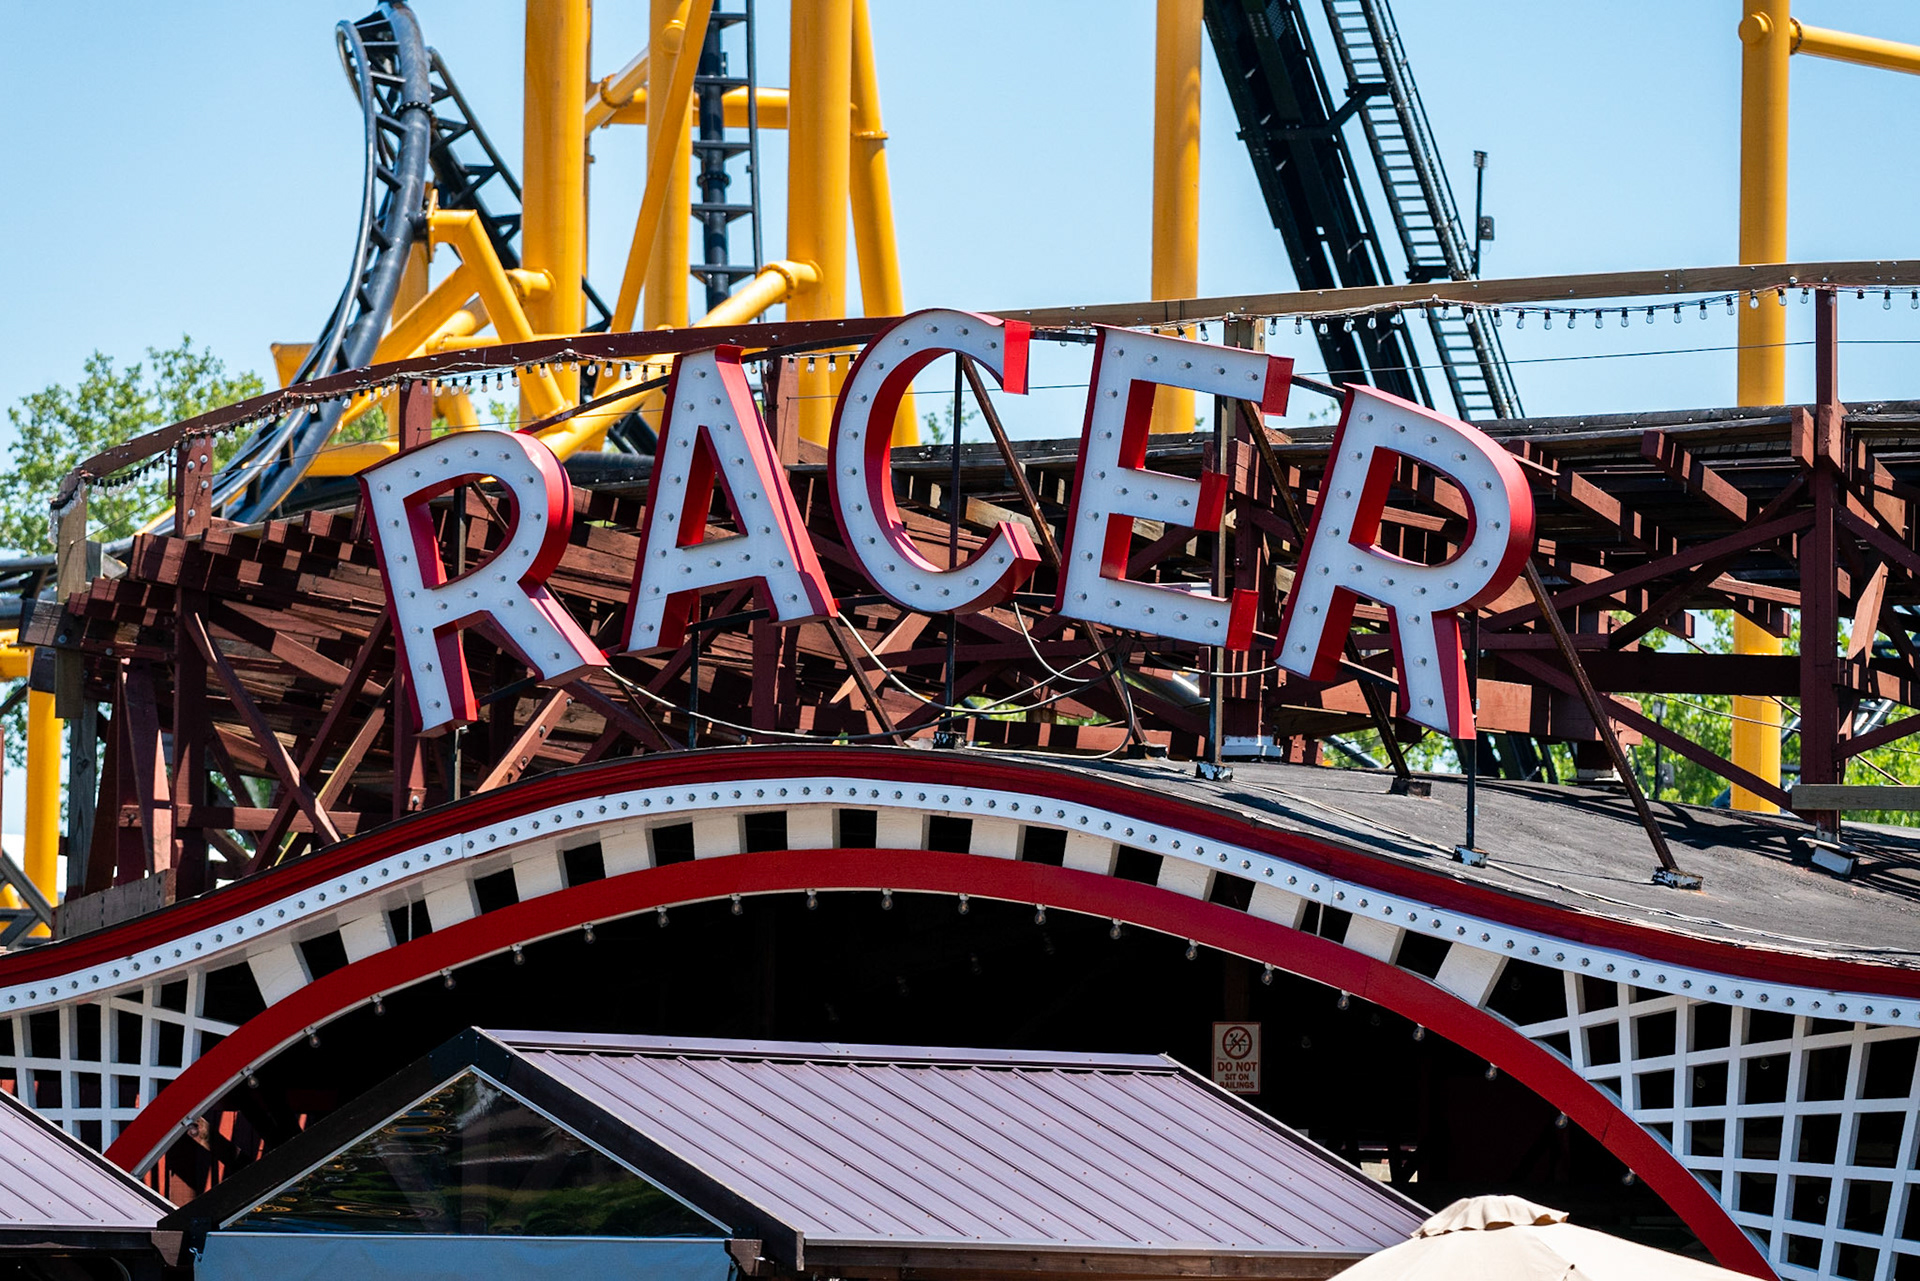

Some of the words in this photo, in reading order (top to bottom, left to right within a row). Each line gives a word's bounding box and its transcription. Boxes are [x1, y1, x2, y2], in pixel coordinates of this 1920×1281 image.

[359, 308, 1535, 739] RACER
[1217, 1061, 1233, 1072] DO
[1235, 1061, 1257, 1072] NOT
[1225, 1073, 1237, 1081] SIT
[1238, 1073, 1250, 1081] ON
